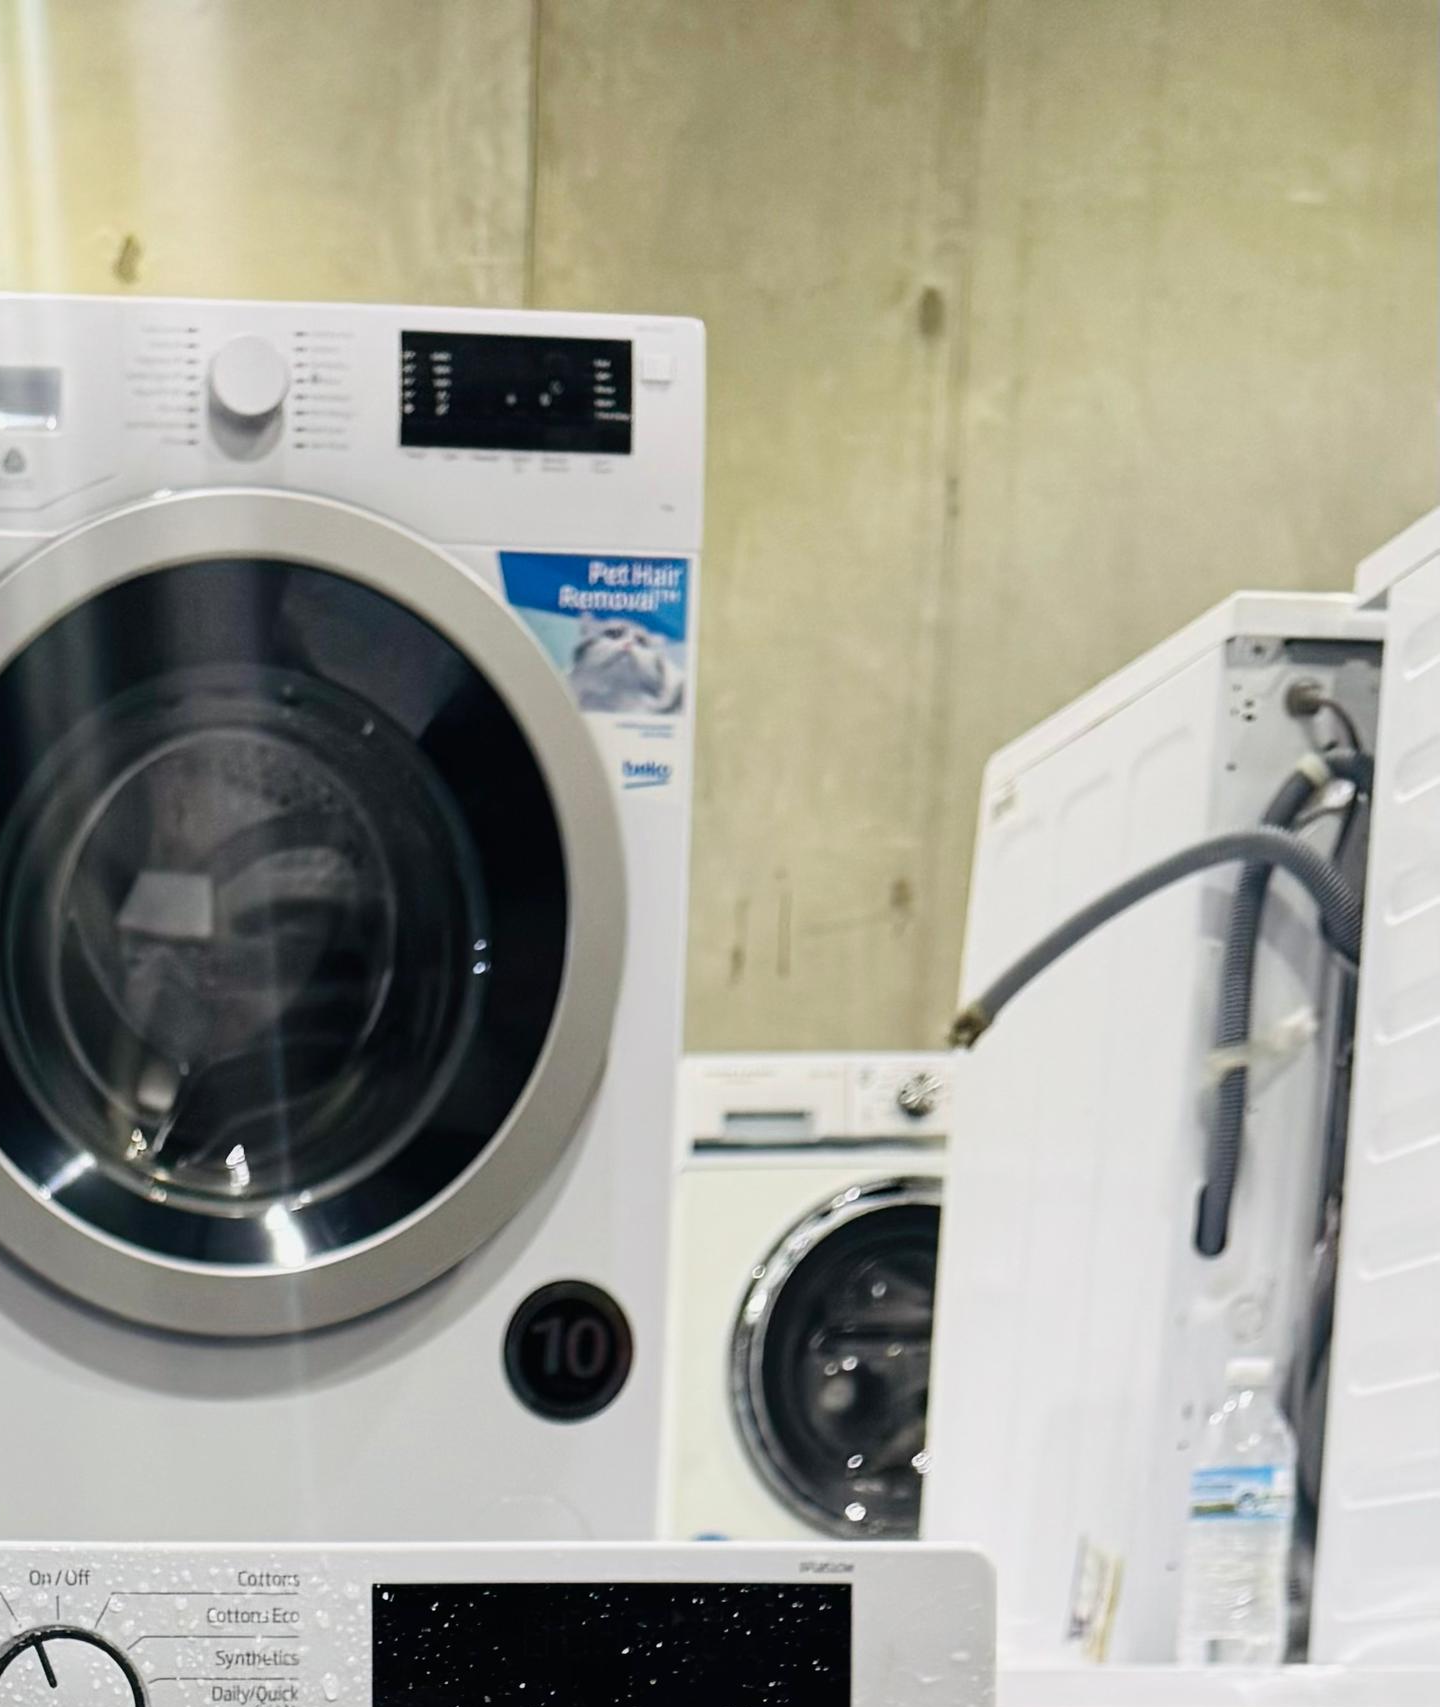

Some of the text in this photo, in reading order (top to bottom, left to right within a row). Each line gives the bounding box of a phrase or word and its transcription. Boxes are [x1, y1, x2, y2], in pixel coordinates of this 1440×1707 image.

[588, 561, 682, 587] Pet Hair
[533, 1318, 607, 1377] 10
[29, 1570, 52, 1586] On
[65, 1569, 90, 1586] Off
[238, 1571, 300, 1587] Cottons
[272, 1608, 300, 1623] Eco
[215, 1650, 300, 1670] Synthetics
[212, 1685, 298, 1705] Daily/Quick
